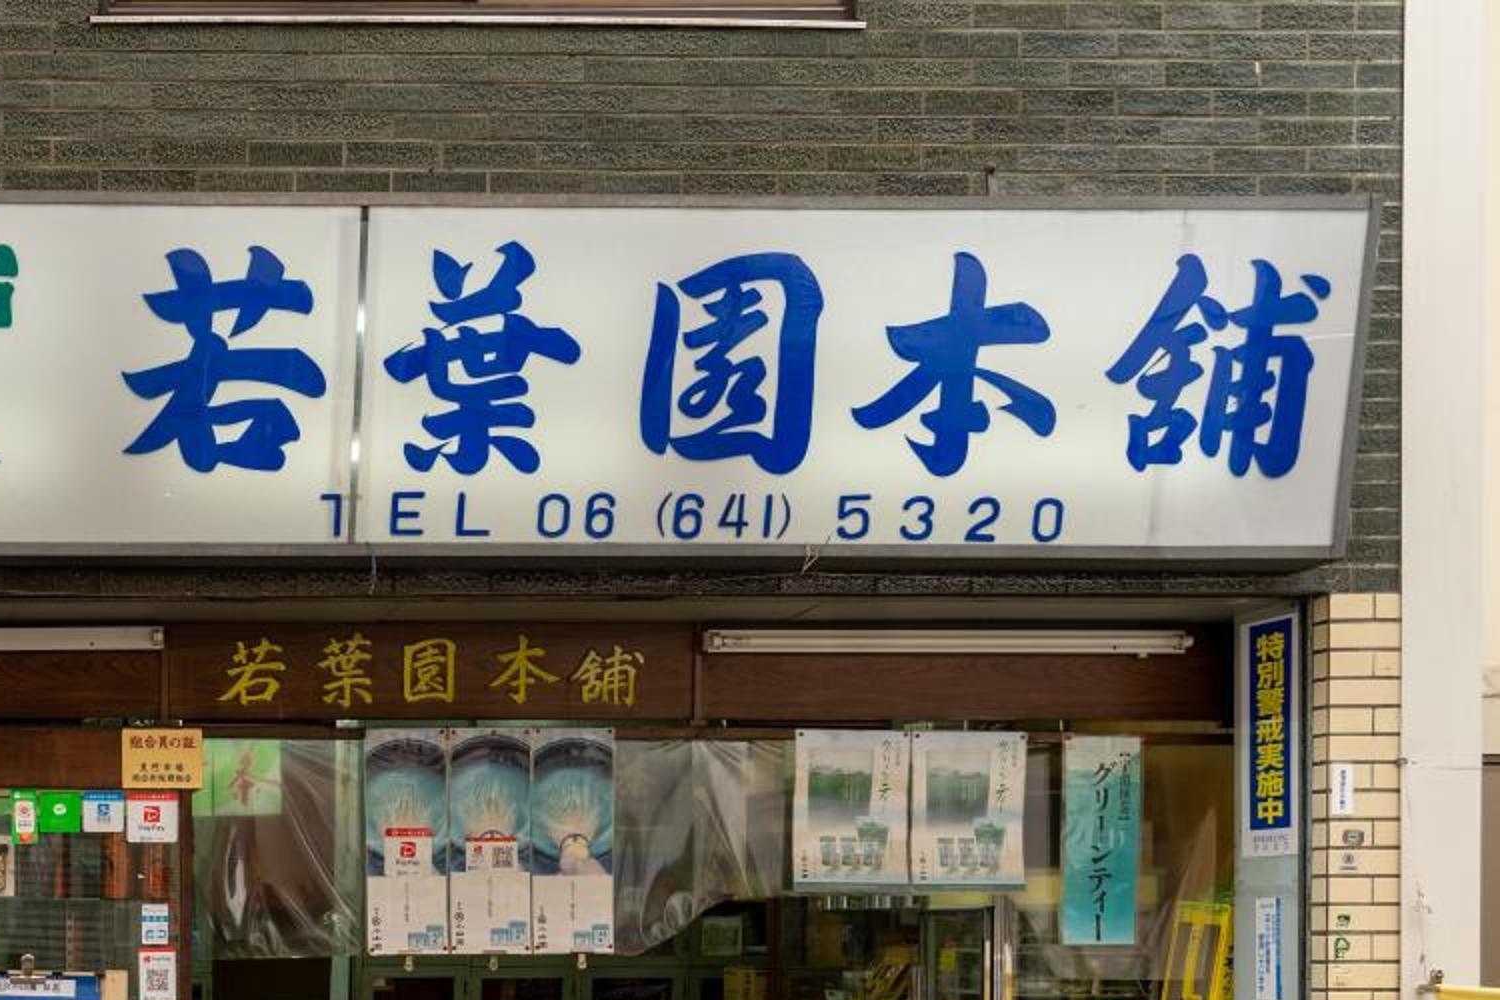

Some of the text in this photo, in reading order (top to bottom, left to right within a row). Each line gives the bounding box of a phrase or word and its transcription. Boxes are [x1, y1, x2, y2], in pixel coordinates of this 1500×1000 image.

[122, 240, 1331, 478] 若葉園本舗
[536, 492, 617, 539] 06
[655, 490, 793, 540] (641)
[835, 492, 1066, 541] 5320
[216, 634, 646, 708] 若葉園本舗
[1256, 631, 1285, 826] 特別警戒実施中
[1087, 761, 1118, 941] グリーンティー
